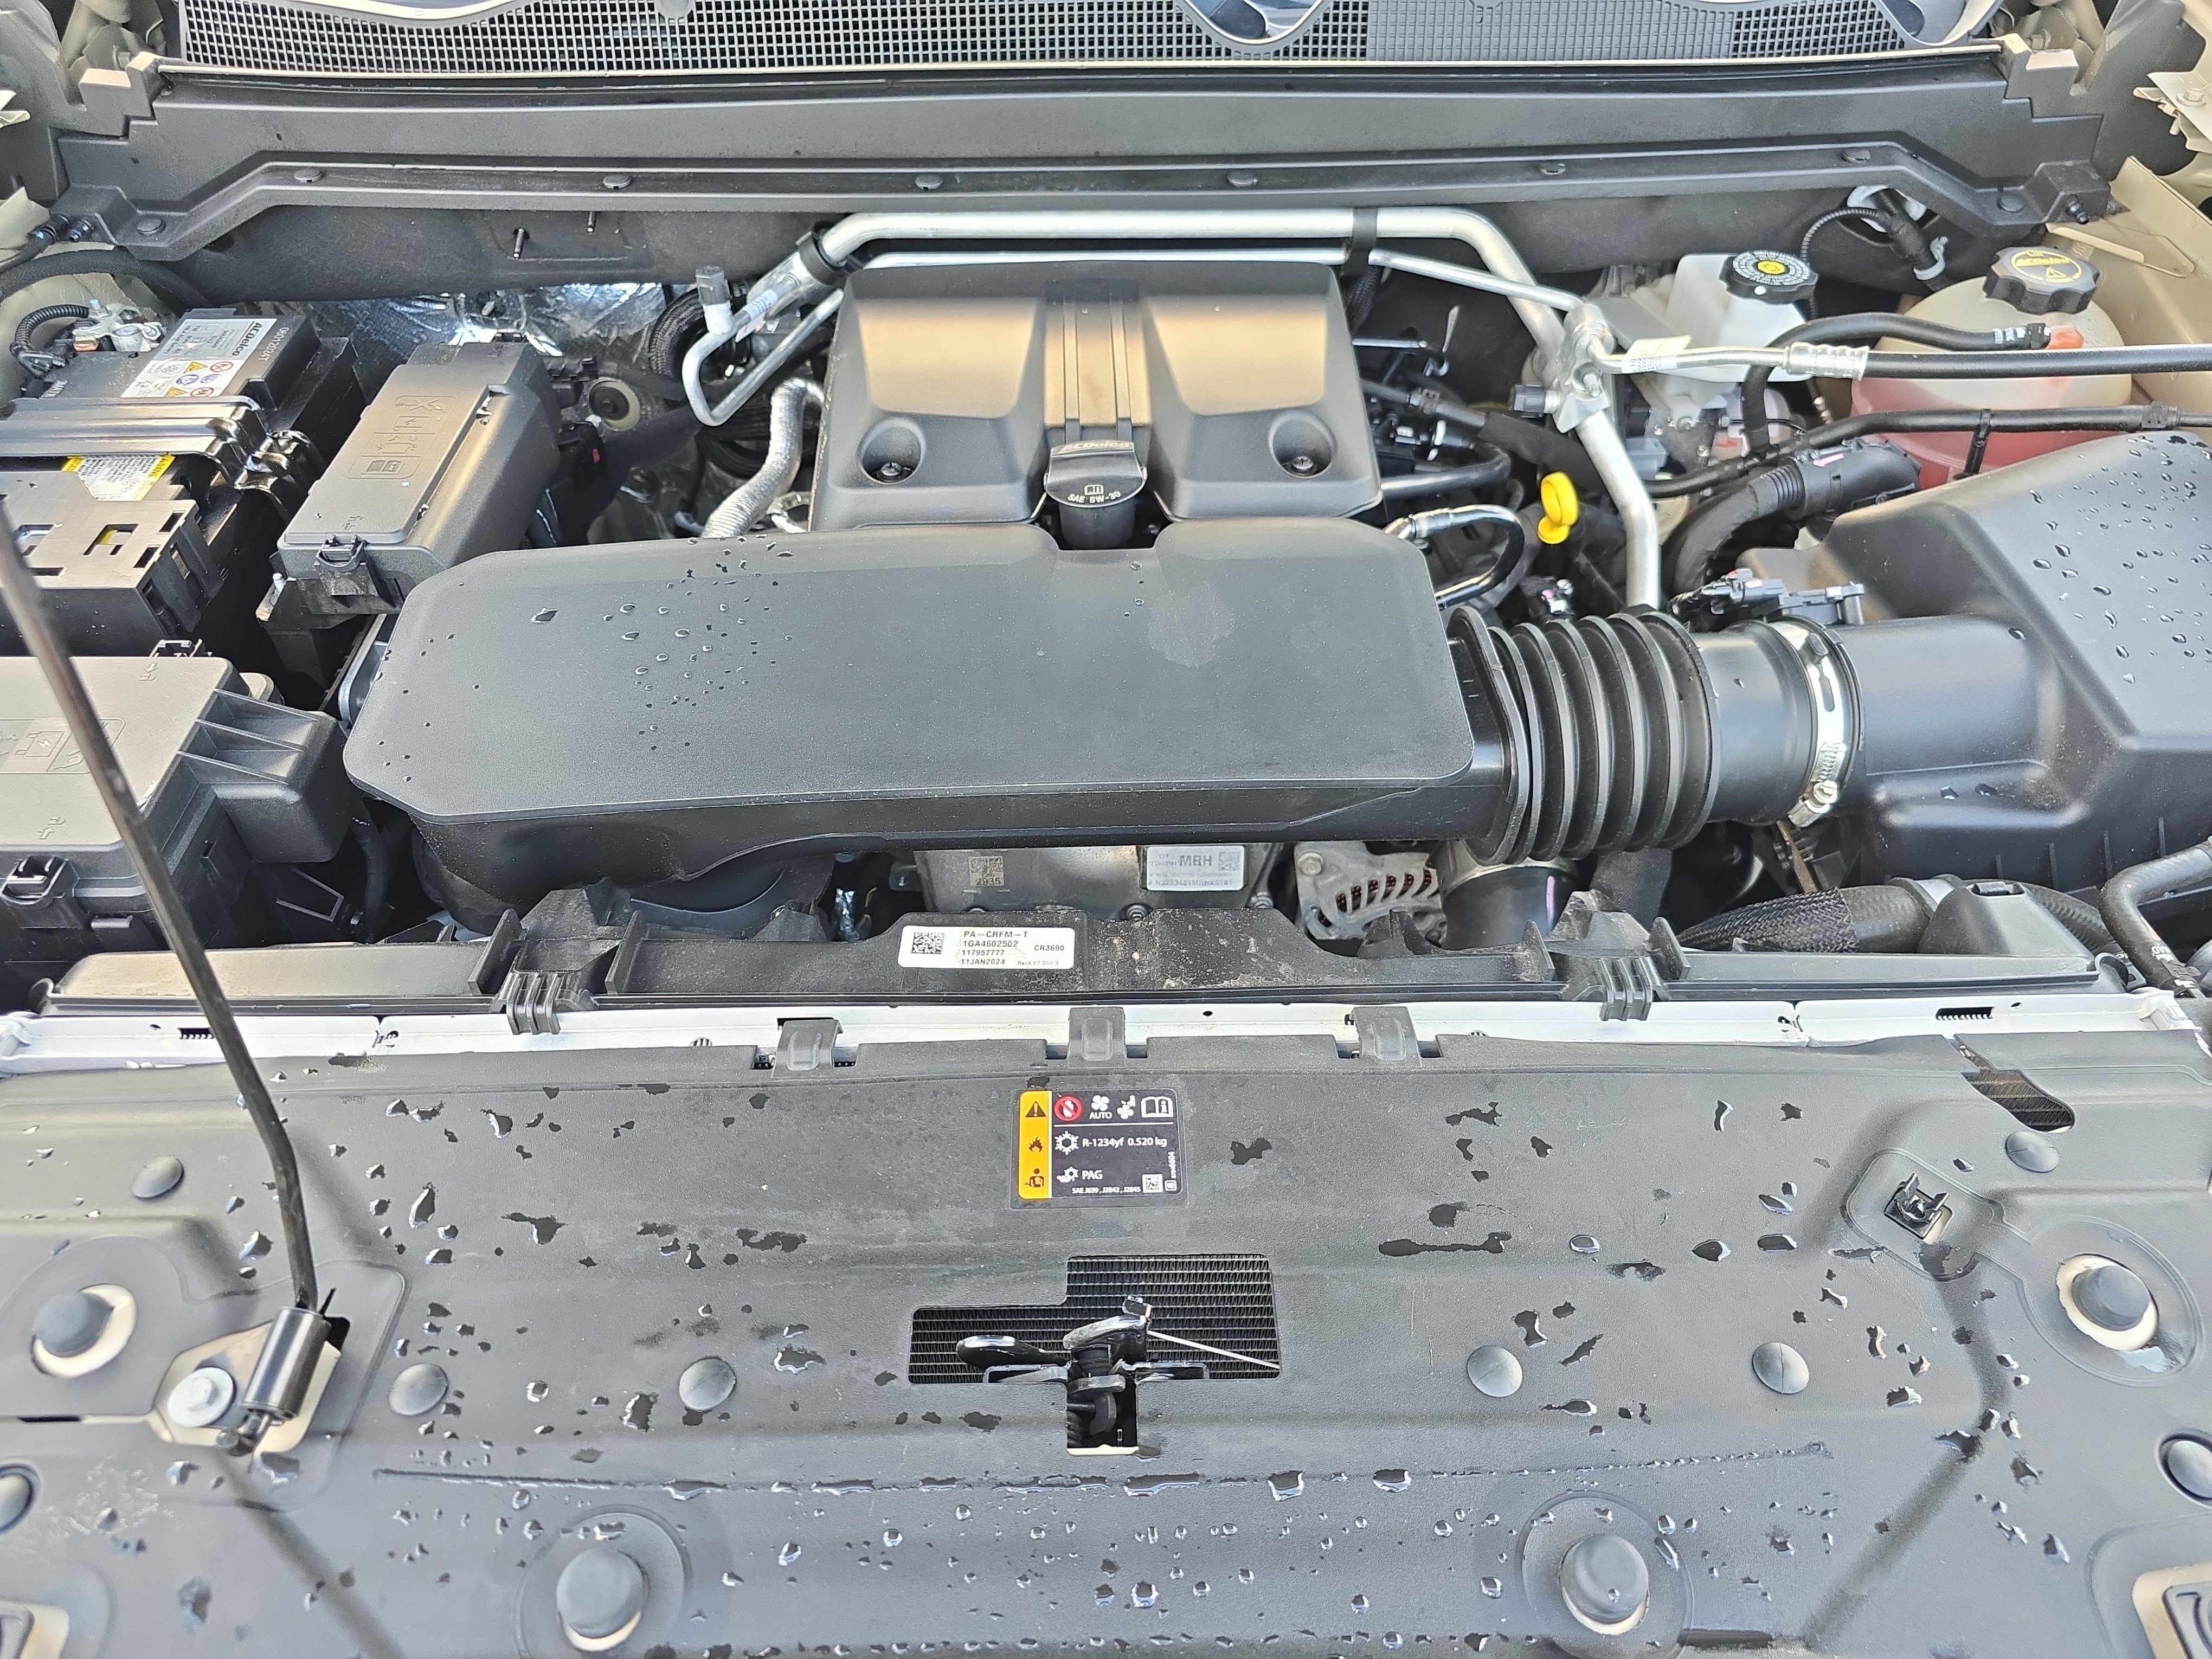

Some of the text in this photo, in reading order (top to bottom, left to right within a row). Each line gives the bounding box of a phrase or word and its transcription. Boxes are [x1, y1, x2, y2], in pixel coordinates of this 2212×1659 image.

[232, 322, 262, 356] ACDelco
[1060, 442, 1130, 452] ACDelco
[1068, 494, 1085, 503] SAE
[1179, 855, 1212, 867] MRH
[1089, 1111, 1113, 1120] AUTO
[1082, 1136, 1167, 1148] R-1234yf 0.520 kg
[1082, 1170, 1103, 1180] PAG
